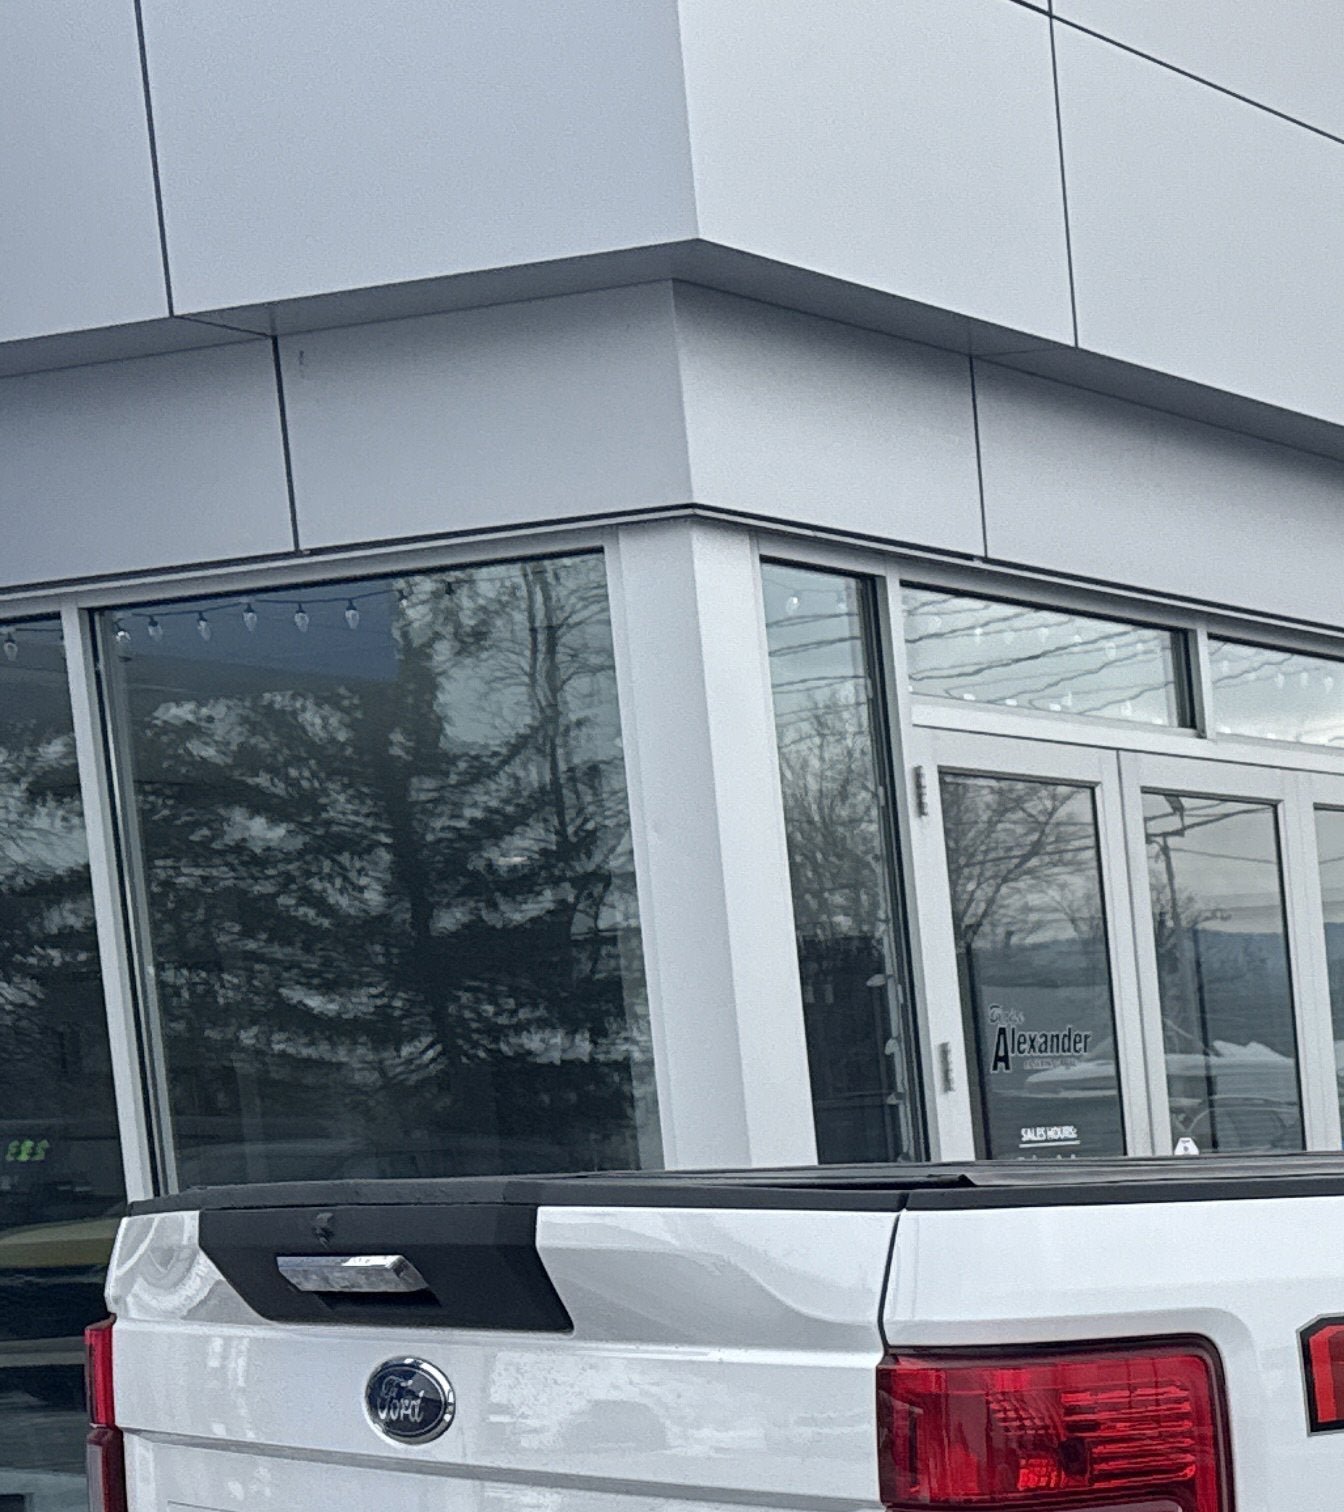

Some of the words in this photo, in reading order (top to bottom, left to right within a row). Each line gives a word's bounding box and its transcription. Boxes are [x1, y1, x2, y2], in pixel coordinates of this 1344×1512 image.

[989, 1025, 1092, 1073] Alexander
[1021, 1127, 1046, 1141] SALES
[376, 1375, 425, 1423] Ford
